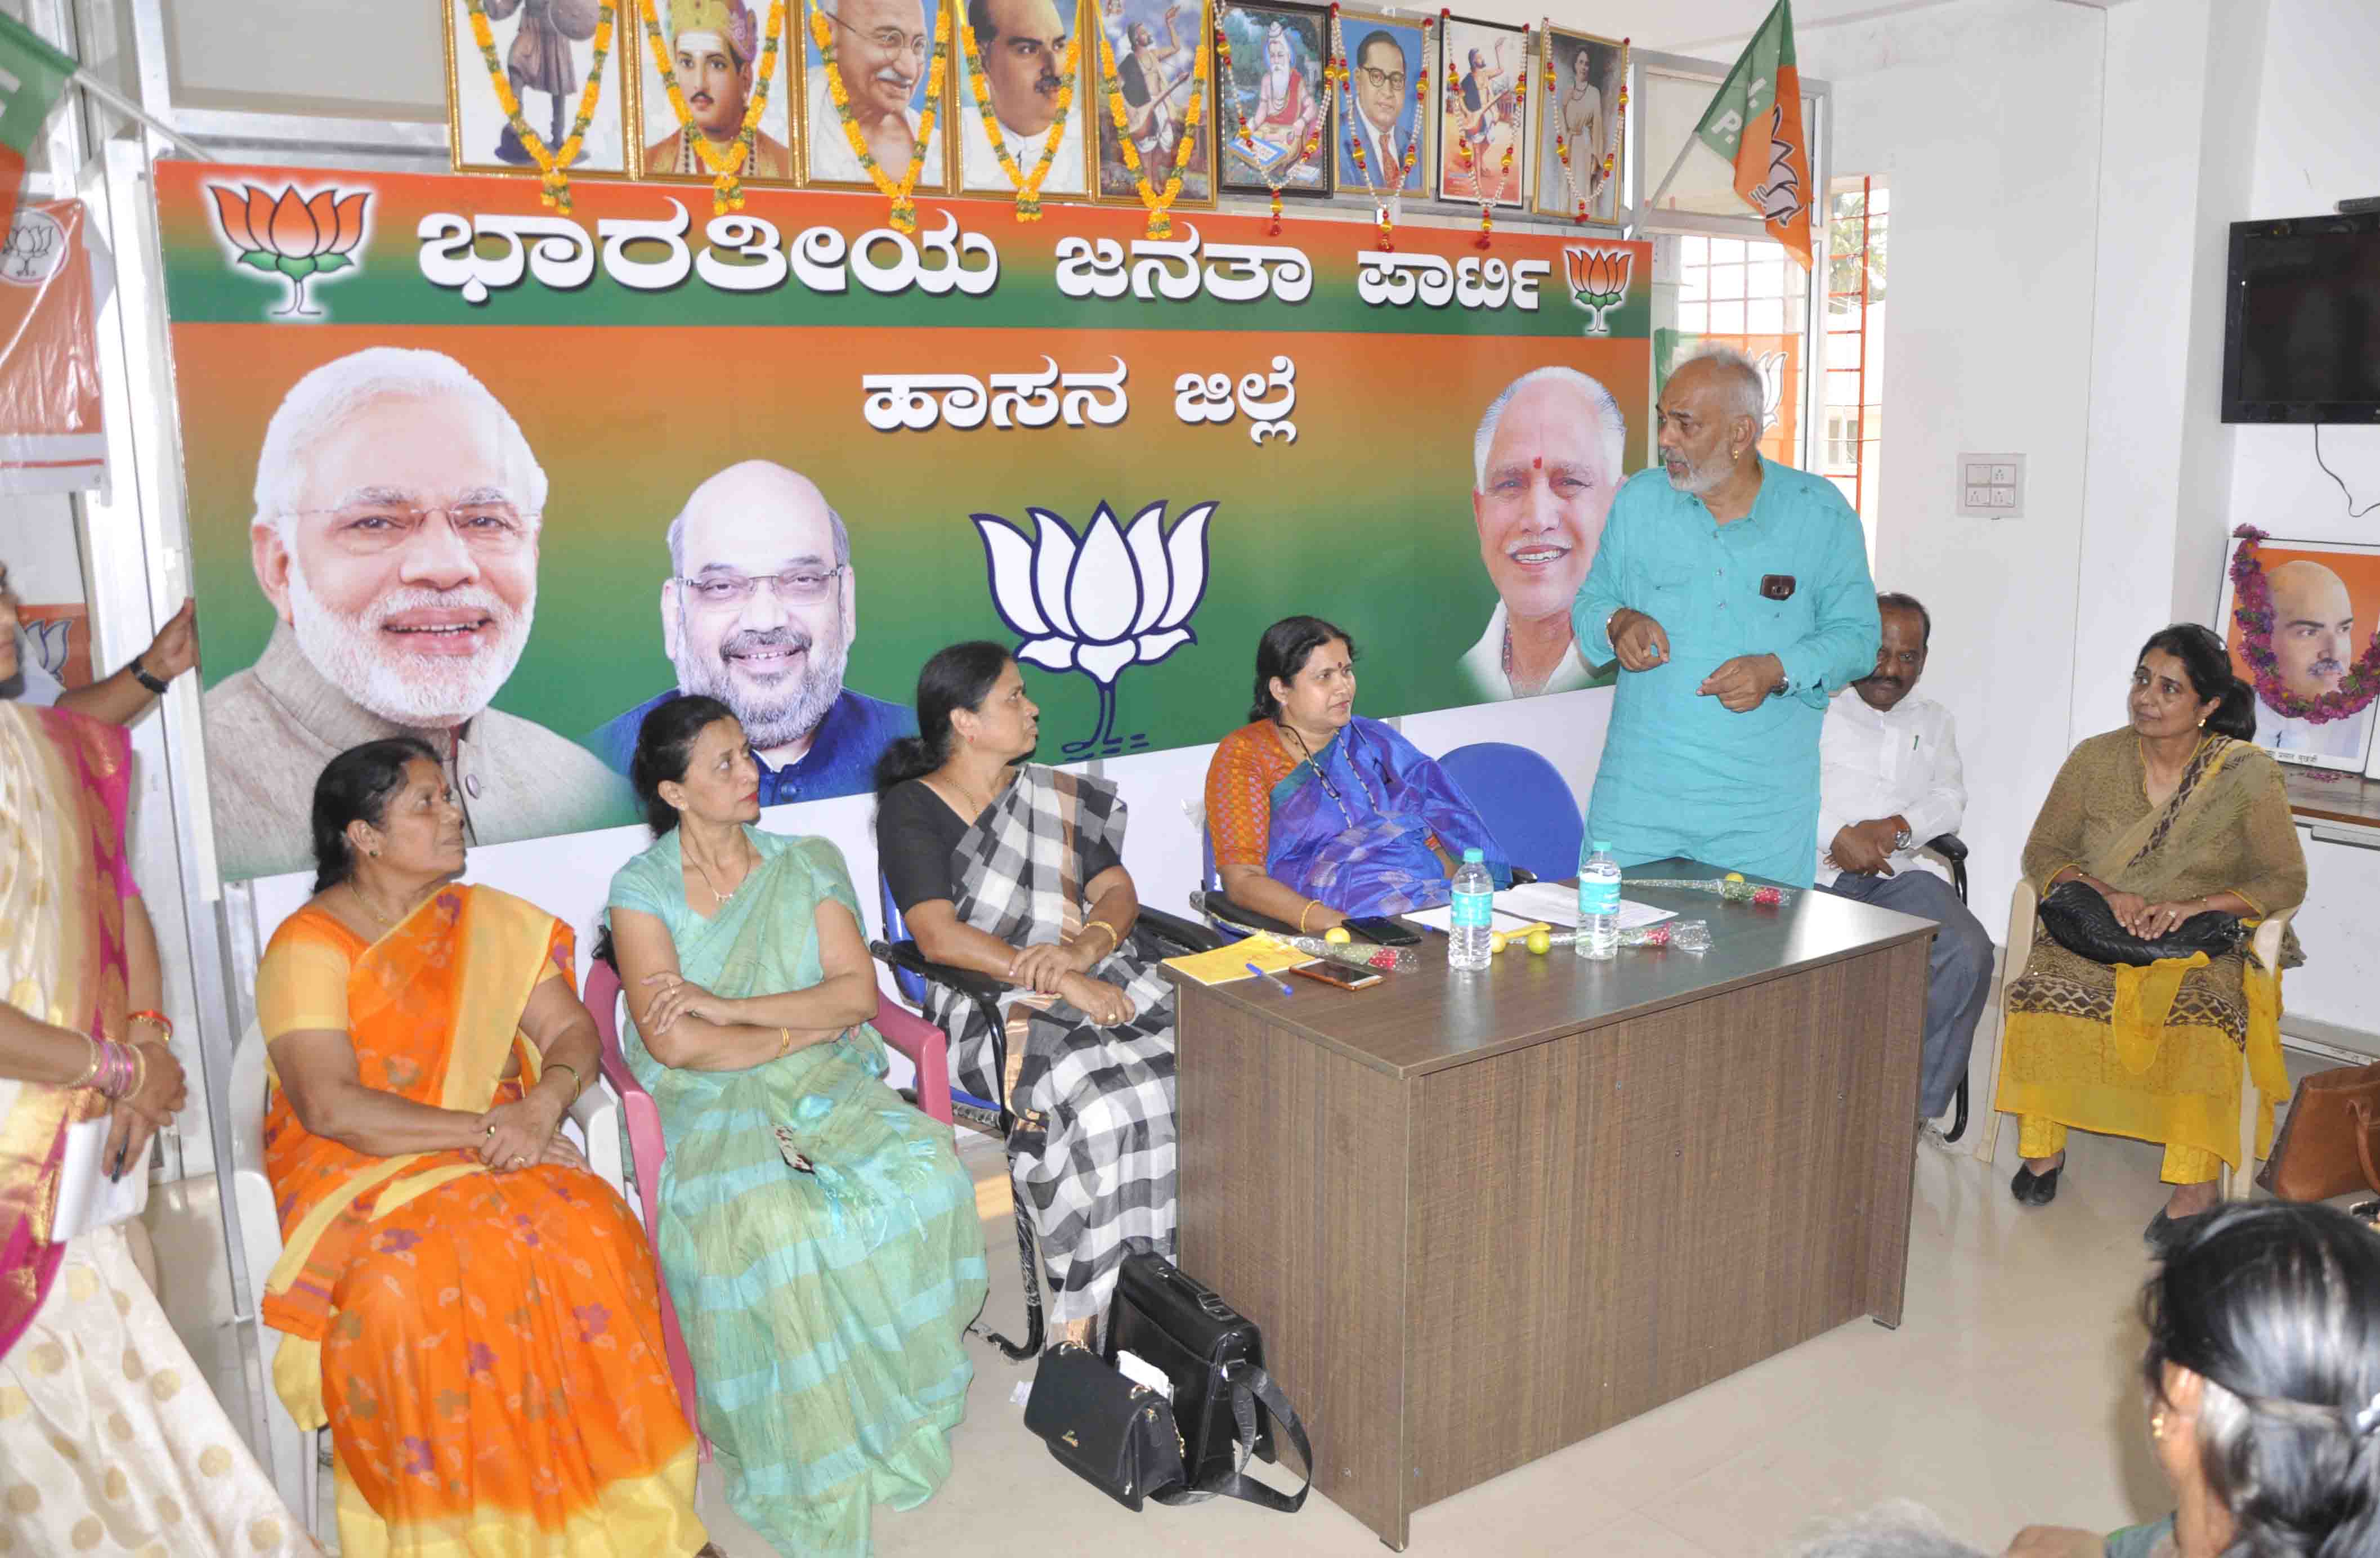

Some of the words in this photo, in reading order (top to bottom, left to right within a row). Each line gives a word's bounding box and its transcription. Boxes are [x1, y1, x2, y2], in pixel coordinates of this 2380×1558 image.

[418, 198, 998, 303] ಭಾರತೀಯ
[1055, 222, 1313, 302] ಜನತಾ
[1357, 250, 1551, 310] ಪಾರ್ಟಿ
[862, 355, 1129, 429] ಹಾಸನ
[1174, 355, 1297, 444] ಜಿಲ್ಲೆ
